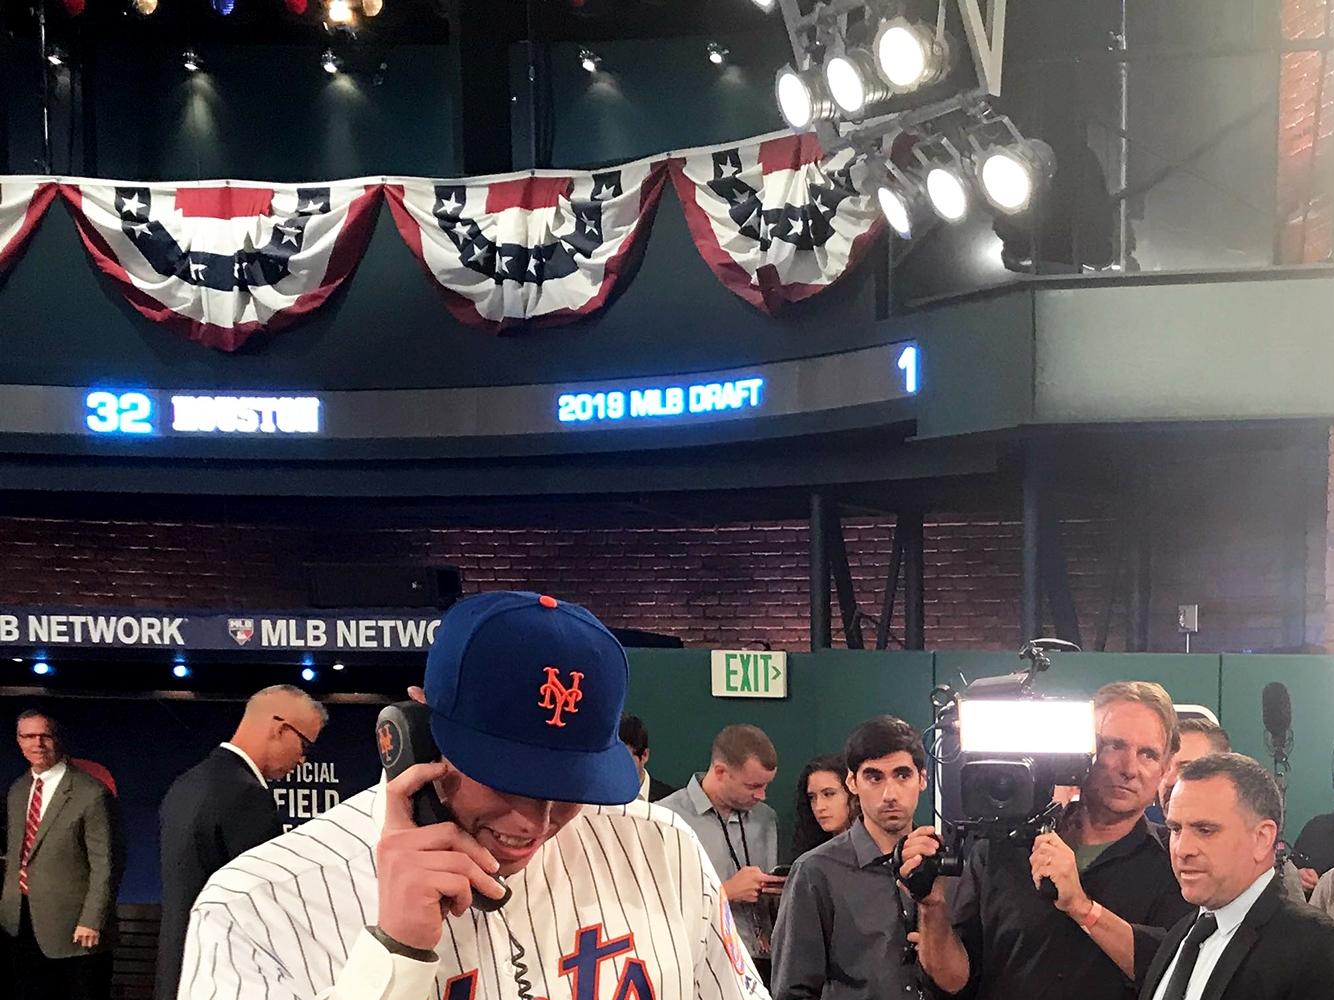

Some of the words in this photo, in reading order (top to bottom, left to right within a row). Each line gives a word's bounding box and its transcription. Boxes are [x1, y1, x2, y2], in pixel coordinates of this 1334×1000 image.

[897, 346, 916, 393] 1
[86, 392, 153, 434] 32
[172, 396, 320, 433] HOUSTON
[558, 392, 624, 421] 2019
[630, 387, 682, 418] MLB
[688, 380, 762, 413] DRAFT
[29, 616, 185, 645] NETWORK
[261, 620, 327, 647] MLB
[725, 653, 772, 692] EXIT
[274, 788, 340, 818] FIELD
